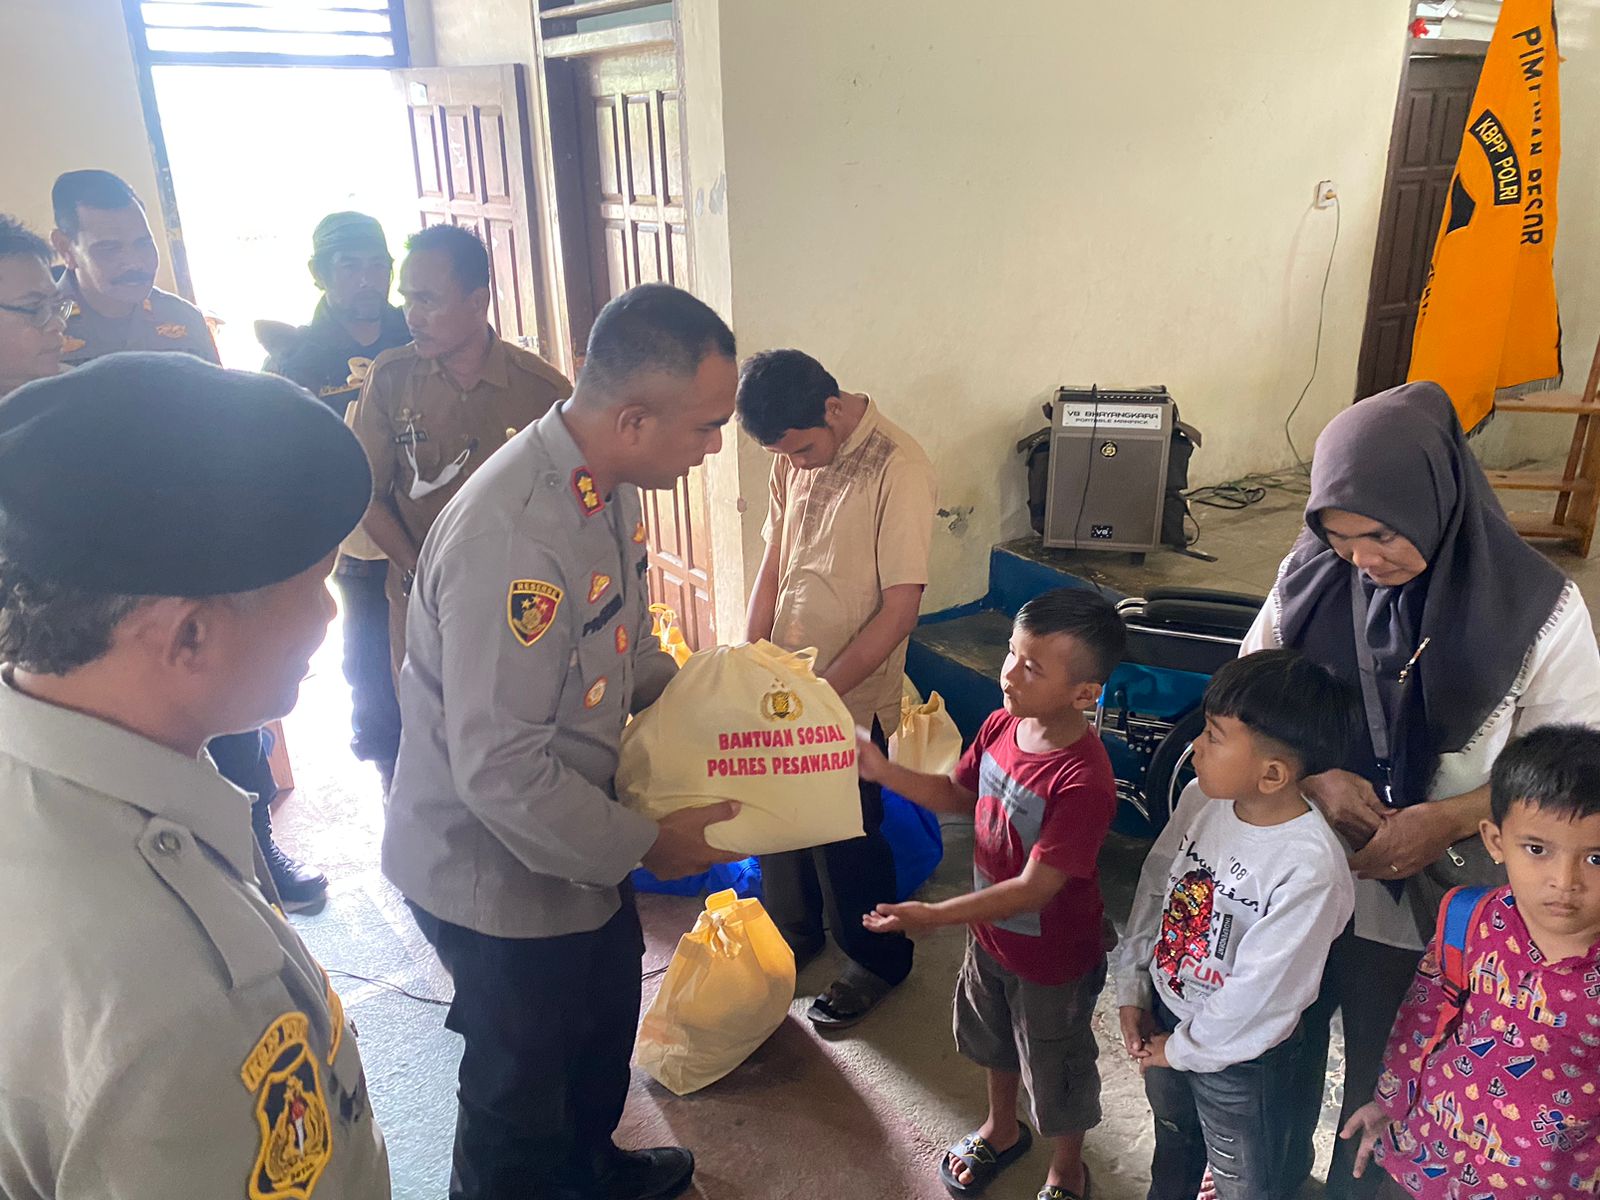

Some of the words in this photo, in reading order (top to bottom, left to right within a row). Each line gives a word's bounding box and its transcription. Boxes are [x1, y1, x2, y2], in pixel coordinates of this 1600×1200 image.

[1475, 117, 1508, 153] KBPP
[1495, 156, 1518, 200] POLRI
[1085, 411, 1159, 420] BHAYANGKARA
[718, 728, 794, 750] BANTUAN
[797, 724, 845, 745] SOSIAL
[707, 757, 767, 777] POLRES
[772, 749, 856, 776] PESAWARAN
